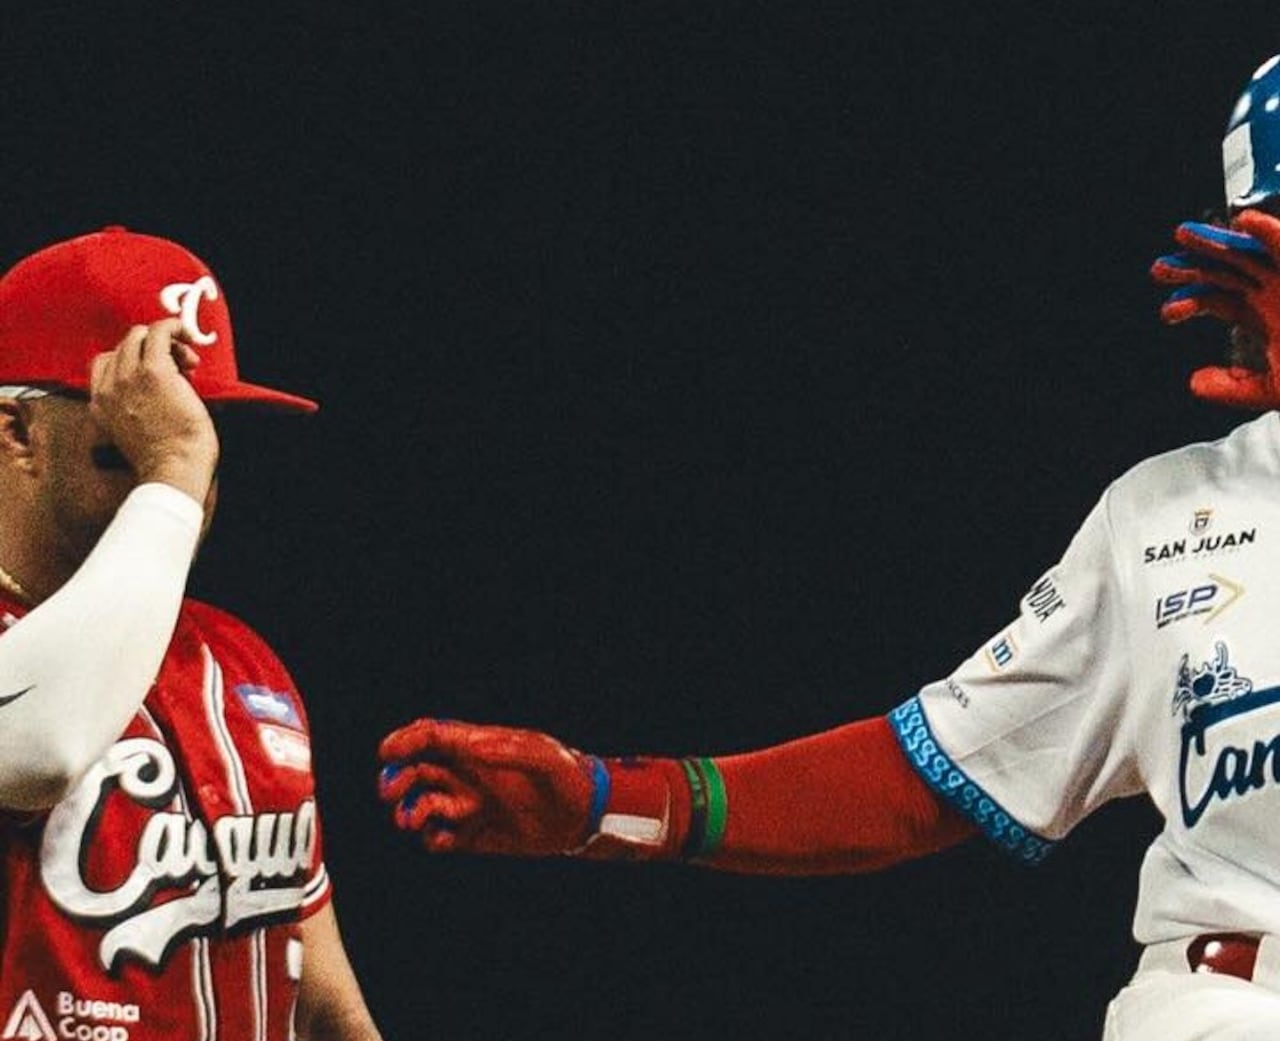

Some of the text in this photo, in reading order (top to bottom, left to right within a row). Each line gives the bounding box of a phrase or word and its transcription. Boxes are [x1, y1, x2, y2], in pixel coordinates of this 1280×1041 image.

[1144, 538, 1186, 564] SAN
[1191, 527, 1257, 554] JUAN
[1156, 584, 1218, 621] ISP
[57, 990, 140, 1023] Buena
